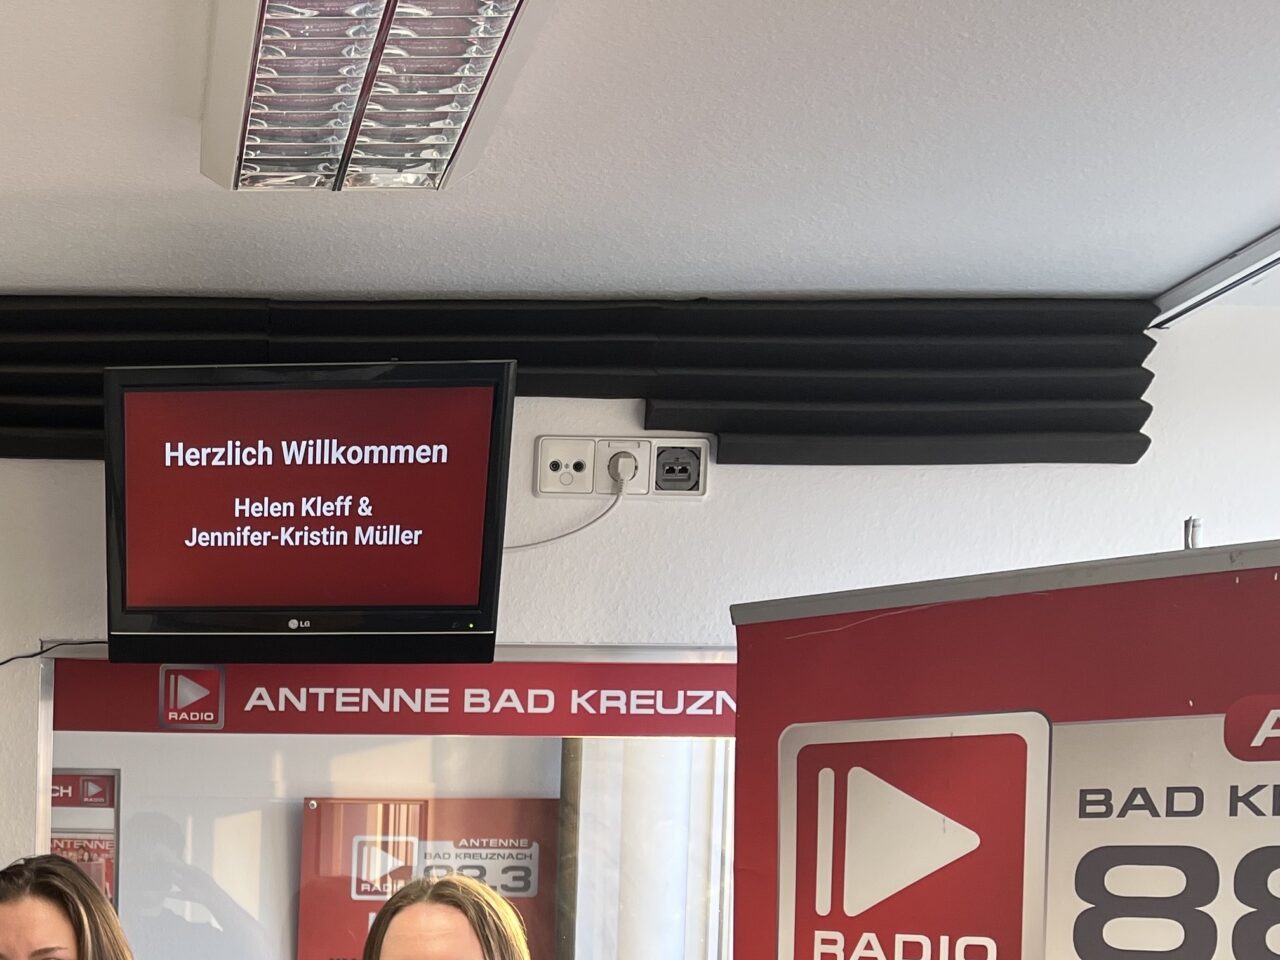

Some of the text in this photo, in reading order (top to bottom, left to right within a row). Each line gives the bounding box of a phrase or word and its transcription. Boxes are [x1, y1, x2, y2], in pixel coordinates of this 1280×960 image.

[165, 440, 448, 467] Herzlich Willkommen
[234, 496, 373, 518] Helen Kleff &
[185, 524, 422, 548] Jennifer-Kristin Müller
[299, 620, 311, 628] LG
[245, 686, 449, 713] ANTENNE
[463, 688, 555, 715] BAD
[168, 711, 214, 721] RADIO
[1078, 786, 1204, 819] BAD
[51, 839, 115, 850] NTENNE
[459, 839, 528, 847] ANTENNE
[424, 852, 532, 860] BAD KREUZNACH
